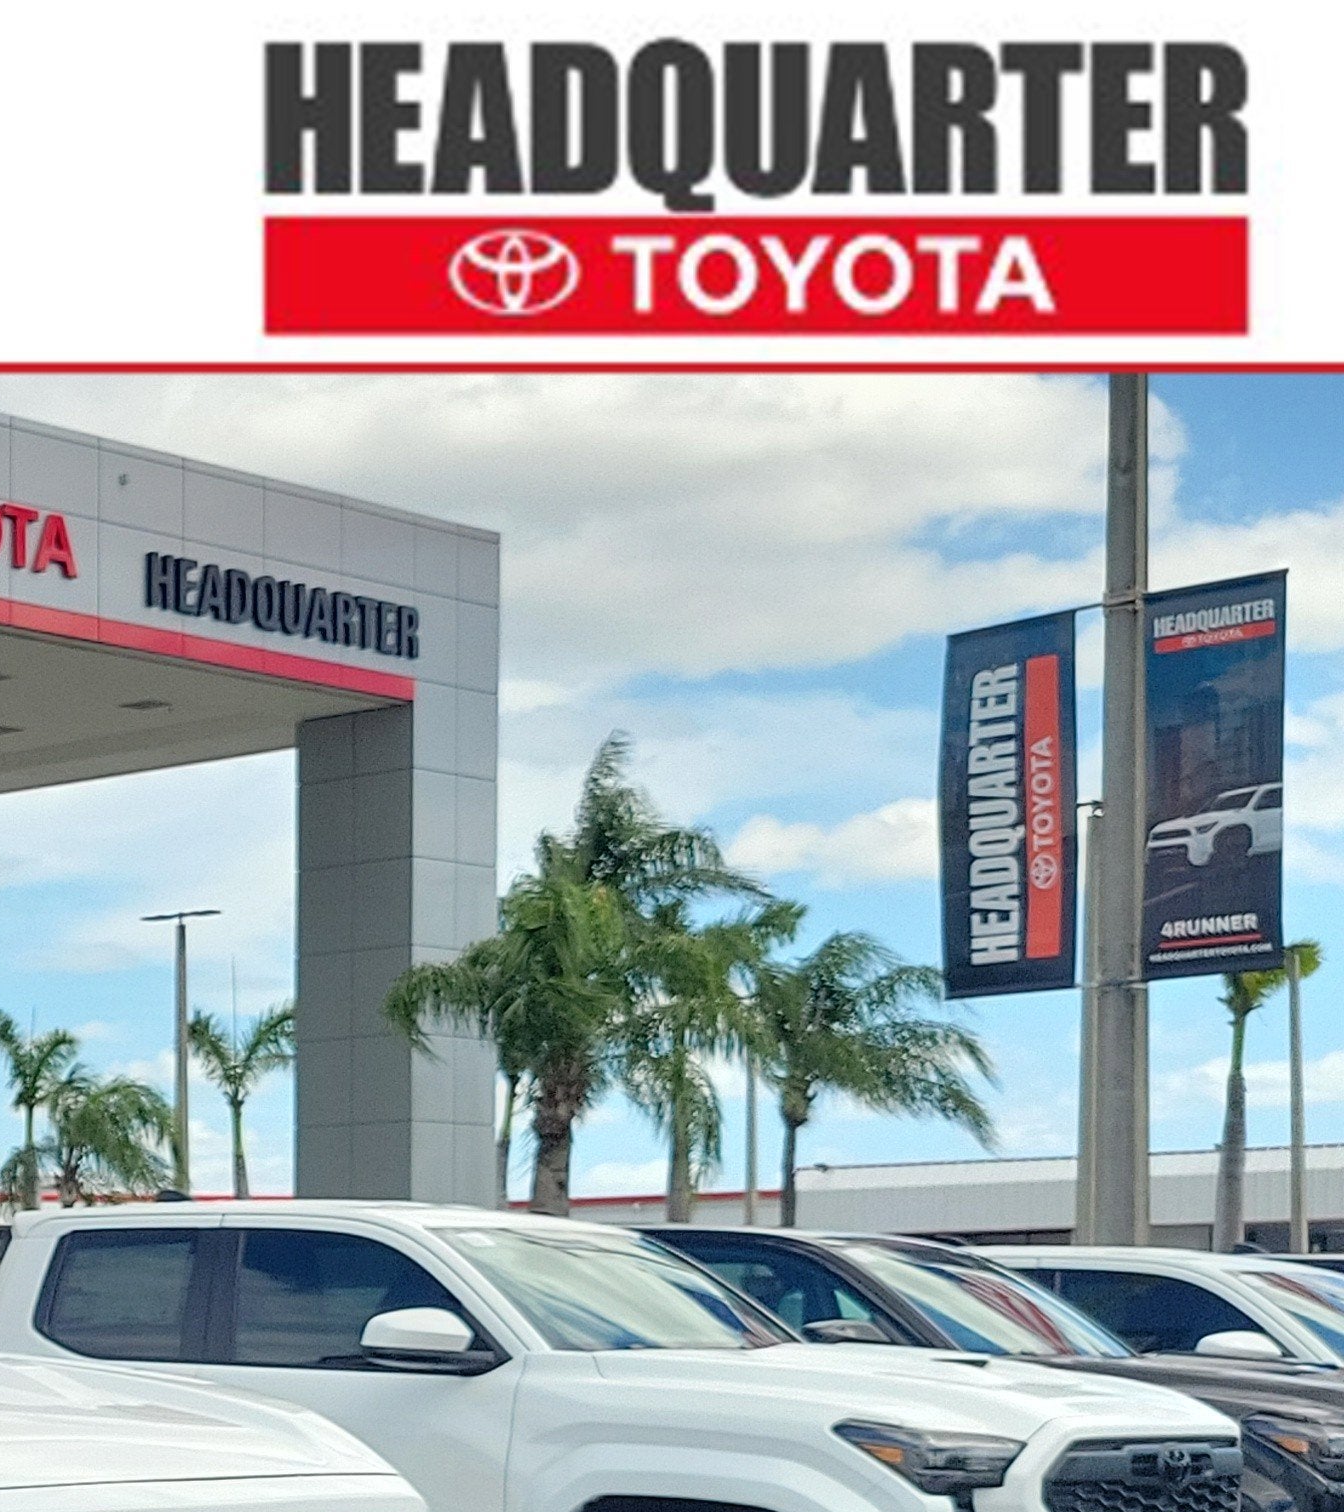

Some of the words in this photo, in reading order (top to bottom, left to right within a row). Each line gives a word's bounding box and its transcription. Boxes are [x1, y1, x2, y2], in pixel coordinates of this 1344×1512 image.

[144, 551, 420, 659] HEADQUARTER
[1152, 598, 1275, 639] HEADQUARTER
[1197, 628, 1244, 644] TOYOTA
[967, 662, 1026, 966] HEADQUARTER
[1030, 735, 1054, 852] TOYOTA
[1159, 912, 1259, 939] 4RUNNER
